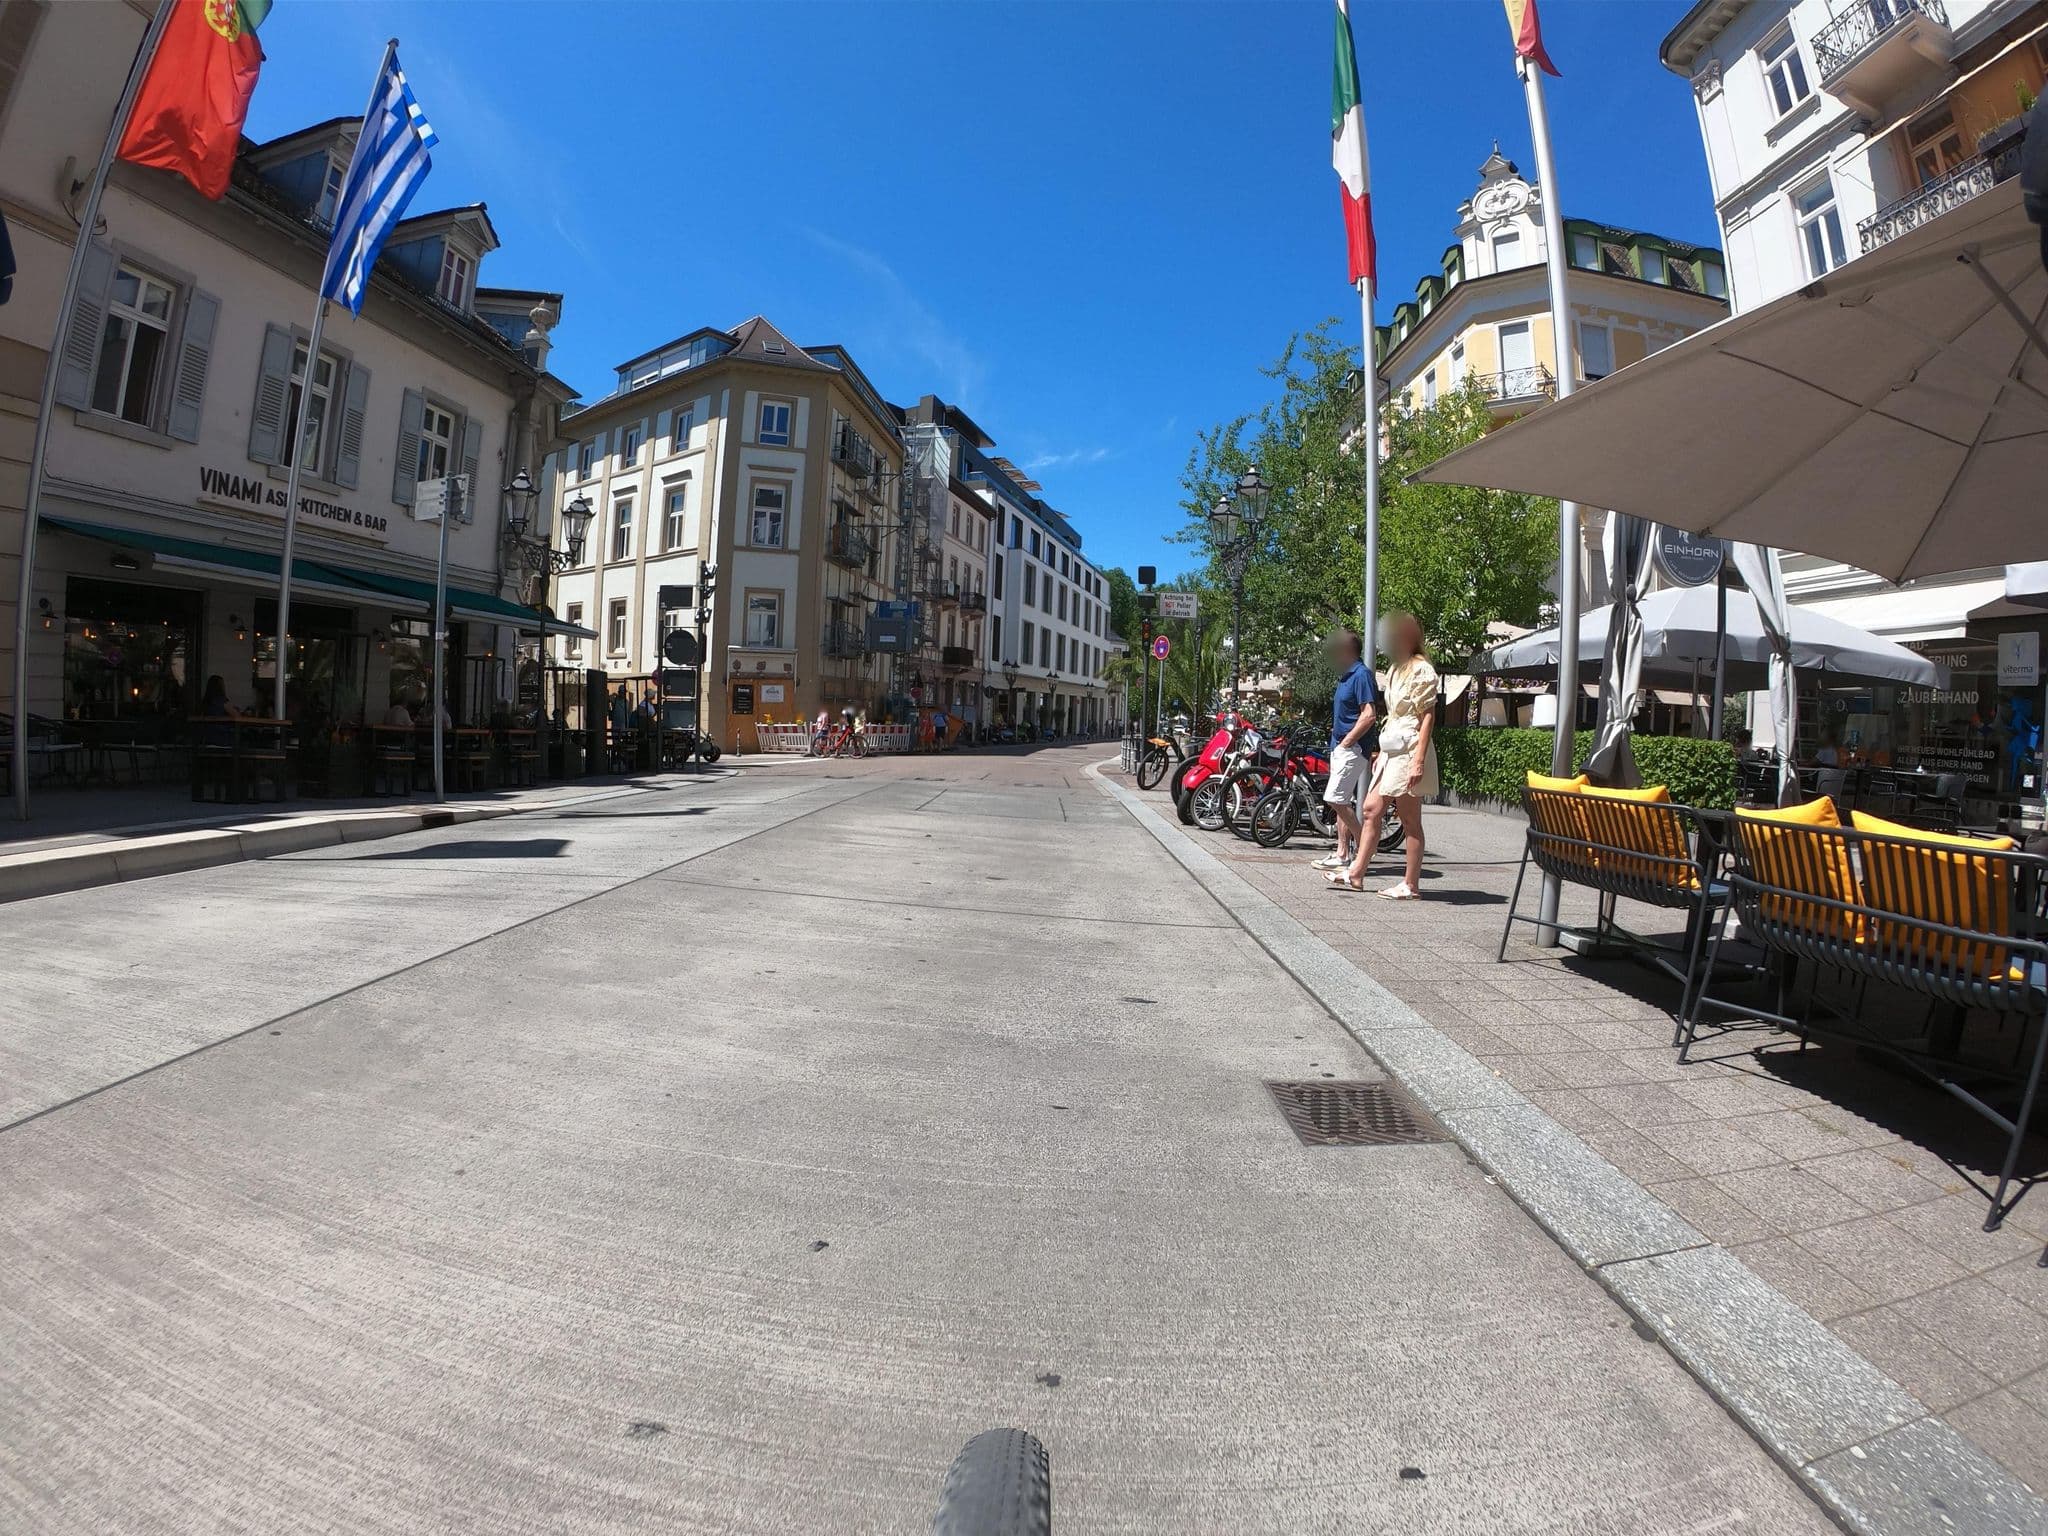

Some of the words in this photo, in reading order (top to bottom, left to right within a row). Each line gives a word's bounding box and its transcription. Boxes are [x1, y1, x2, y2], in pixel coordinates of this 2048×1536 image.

[200, 467, 262, 504] VINAMI
[266, 488, 351, 523] ASI-KITCHEN
[354, 512, 362, 526] &
[365, 515, 387, 532] BAR
[1664, 544, 1719, 558] EINHORN
[1164, 594, 1183, 602] Achtung
[2002, 664, 2034, 674] viterma
[1937, 747, 1995, 759] WOHLFÜHLBAD
[1921, 758, 1935, 767] AUS
[1937, 759, 1959, 768] EINER
[1961, 761, 1983, 770] HAND
